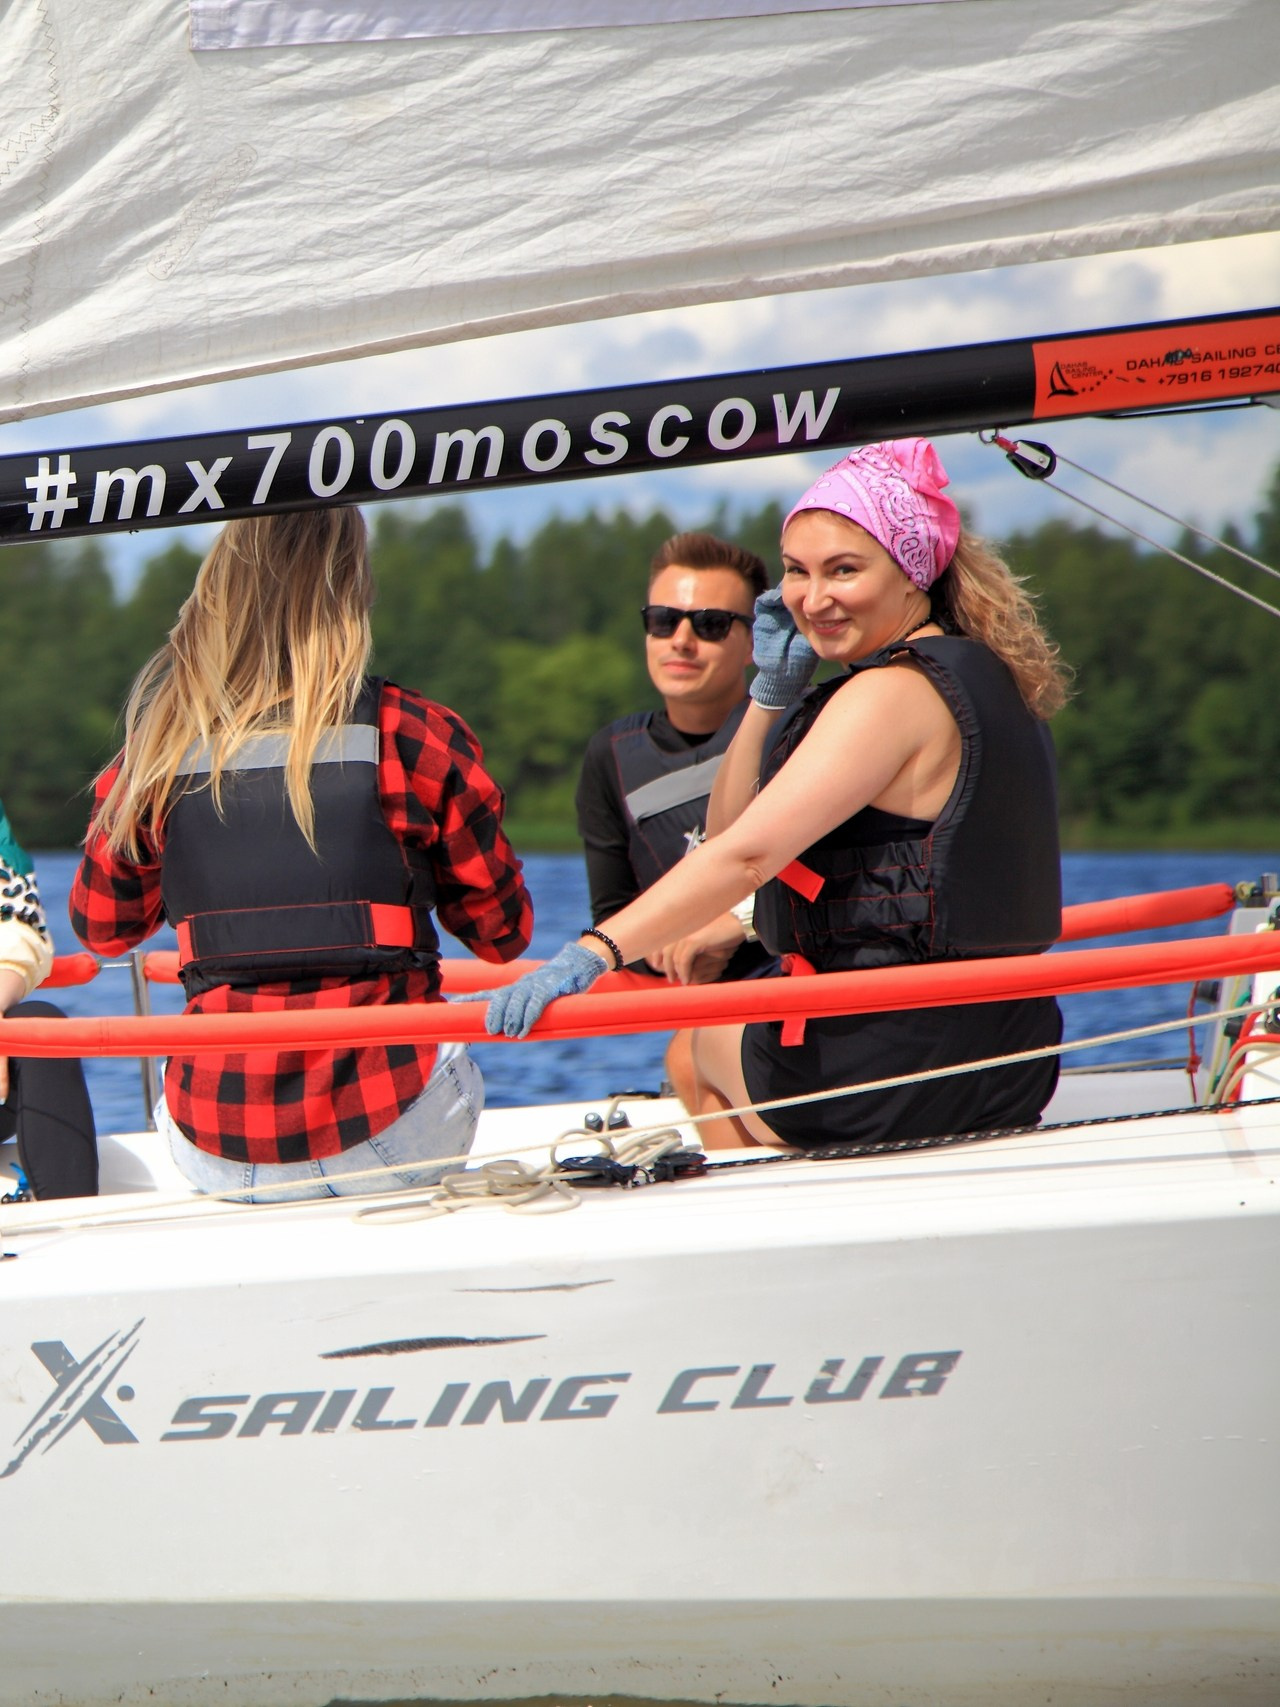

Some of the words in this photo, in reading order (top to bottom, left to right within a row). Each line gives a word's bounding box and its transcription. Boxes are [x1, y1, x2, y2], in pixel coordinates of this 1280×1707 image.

[1158, 371, 1212, 386] +7916
[1192, 347, 1256, 364] SAILING
[25, 387, 841, 531] #mx700moscow
[160, 1372, 632, 1442] SAILING
[656, 1350, 963, 1414] CLUB
